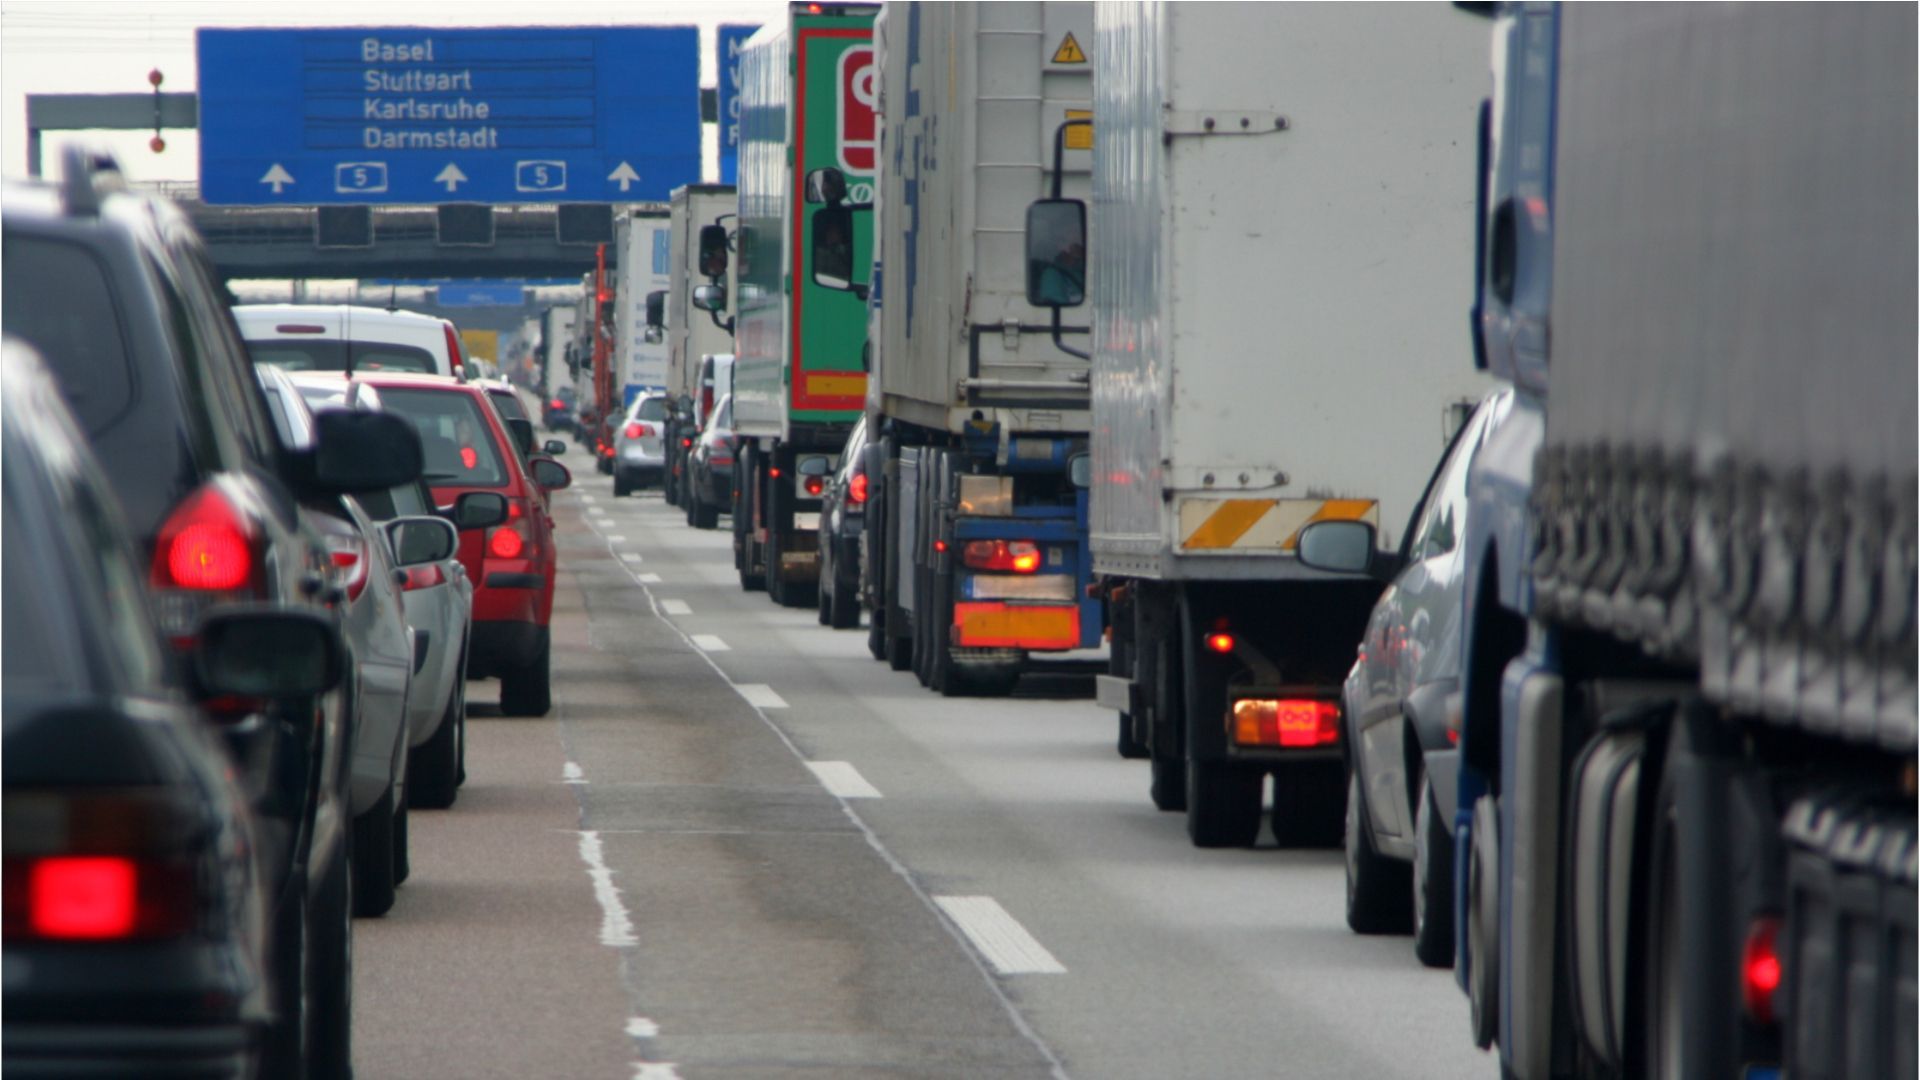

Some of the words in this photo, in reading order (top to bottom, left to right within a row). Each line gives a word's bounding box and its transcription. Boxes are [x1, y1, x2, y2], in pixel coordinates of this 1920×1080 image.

[362, 38, 433, 61] Basel
[364, 70, 472, 91] Stuttgart
[364, 98, 489, 119] Karlsruhe
[364, 126, 498, 148] Darmstadt
[354, 168, 367, 186] 5
[535, 166, 547, 185] 5
